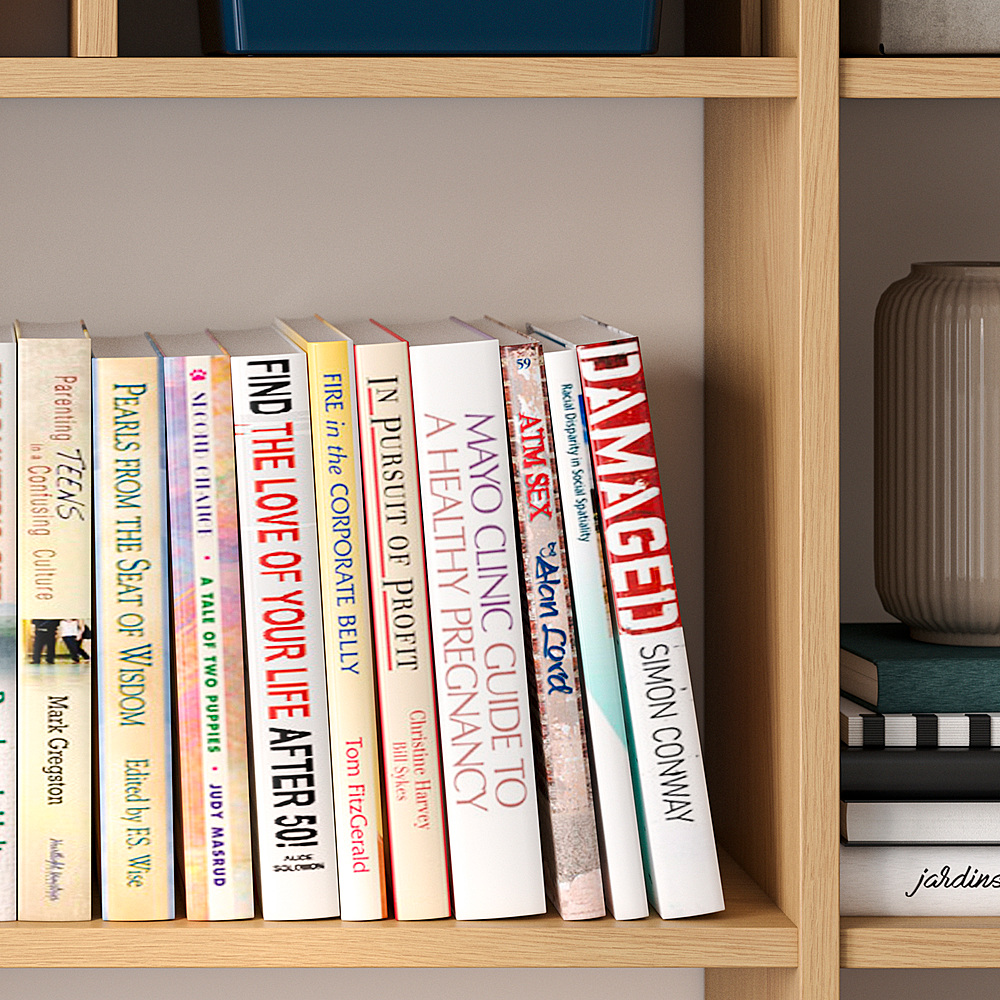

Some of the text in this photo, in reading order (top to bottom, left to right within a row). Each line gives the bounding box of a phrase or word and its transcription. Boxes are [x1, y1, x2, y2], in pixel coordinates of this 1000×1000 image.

[49, 375, 86, 521] Parenting TEENS
[518, 413, 553, 520] ATM SEX
[561, 383, 590, 542] Racial Disparity Social Spatiality
[580, 347, 681, 634] DAMAGED
[27, 465, 56, 601] Confusing Culture
[113, 382, 153, 727] PEARLS FROM THE SEAT OF WISDOM
[323, 373, 360, 675] FIRE in the CORPORATE BELLY
[366, 375, 419, 671] IN PURSUIT OF PROFIT
[199, 577, 215, 587] A
[200, 591, 216, 625] TALE
[247, 358, 319, 849] FIND THE LOVE OF YOUR LIFE AFTER 50!
[424, 413, 488, 813] A HEALTHY PREGNANCY
[463, 413, 528, 809] MAYO CLINIC GUIDE TO
[536, 556, 573, 696] Alan Lord
[201, 631, 217, 650] OF
[203, 653, 219, 687] TWO
[45, 695, 69, 733] Mark
[205, 694, 222, 754] PUPPIES
[408, 709, 433, 830] Christine Harvey
[639, 644, 694, 824] SIMON CONWAY
[39, 737, 69, 806] Gregston
[122, 804, 149, 822] by
[124, 758, 149, 801] Edited
[208, 783, 226, 822] JUDY
[344, 736, 371, 874] Tom FitzGerald
[392, 741, 412, 802] Bill Sykes
[127, 855, 151, 888] Wise
[210, 826, 227, 887] MASRUD
